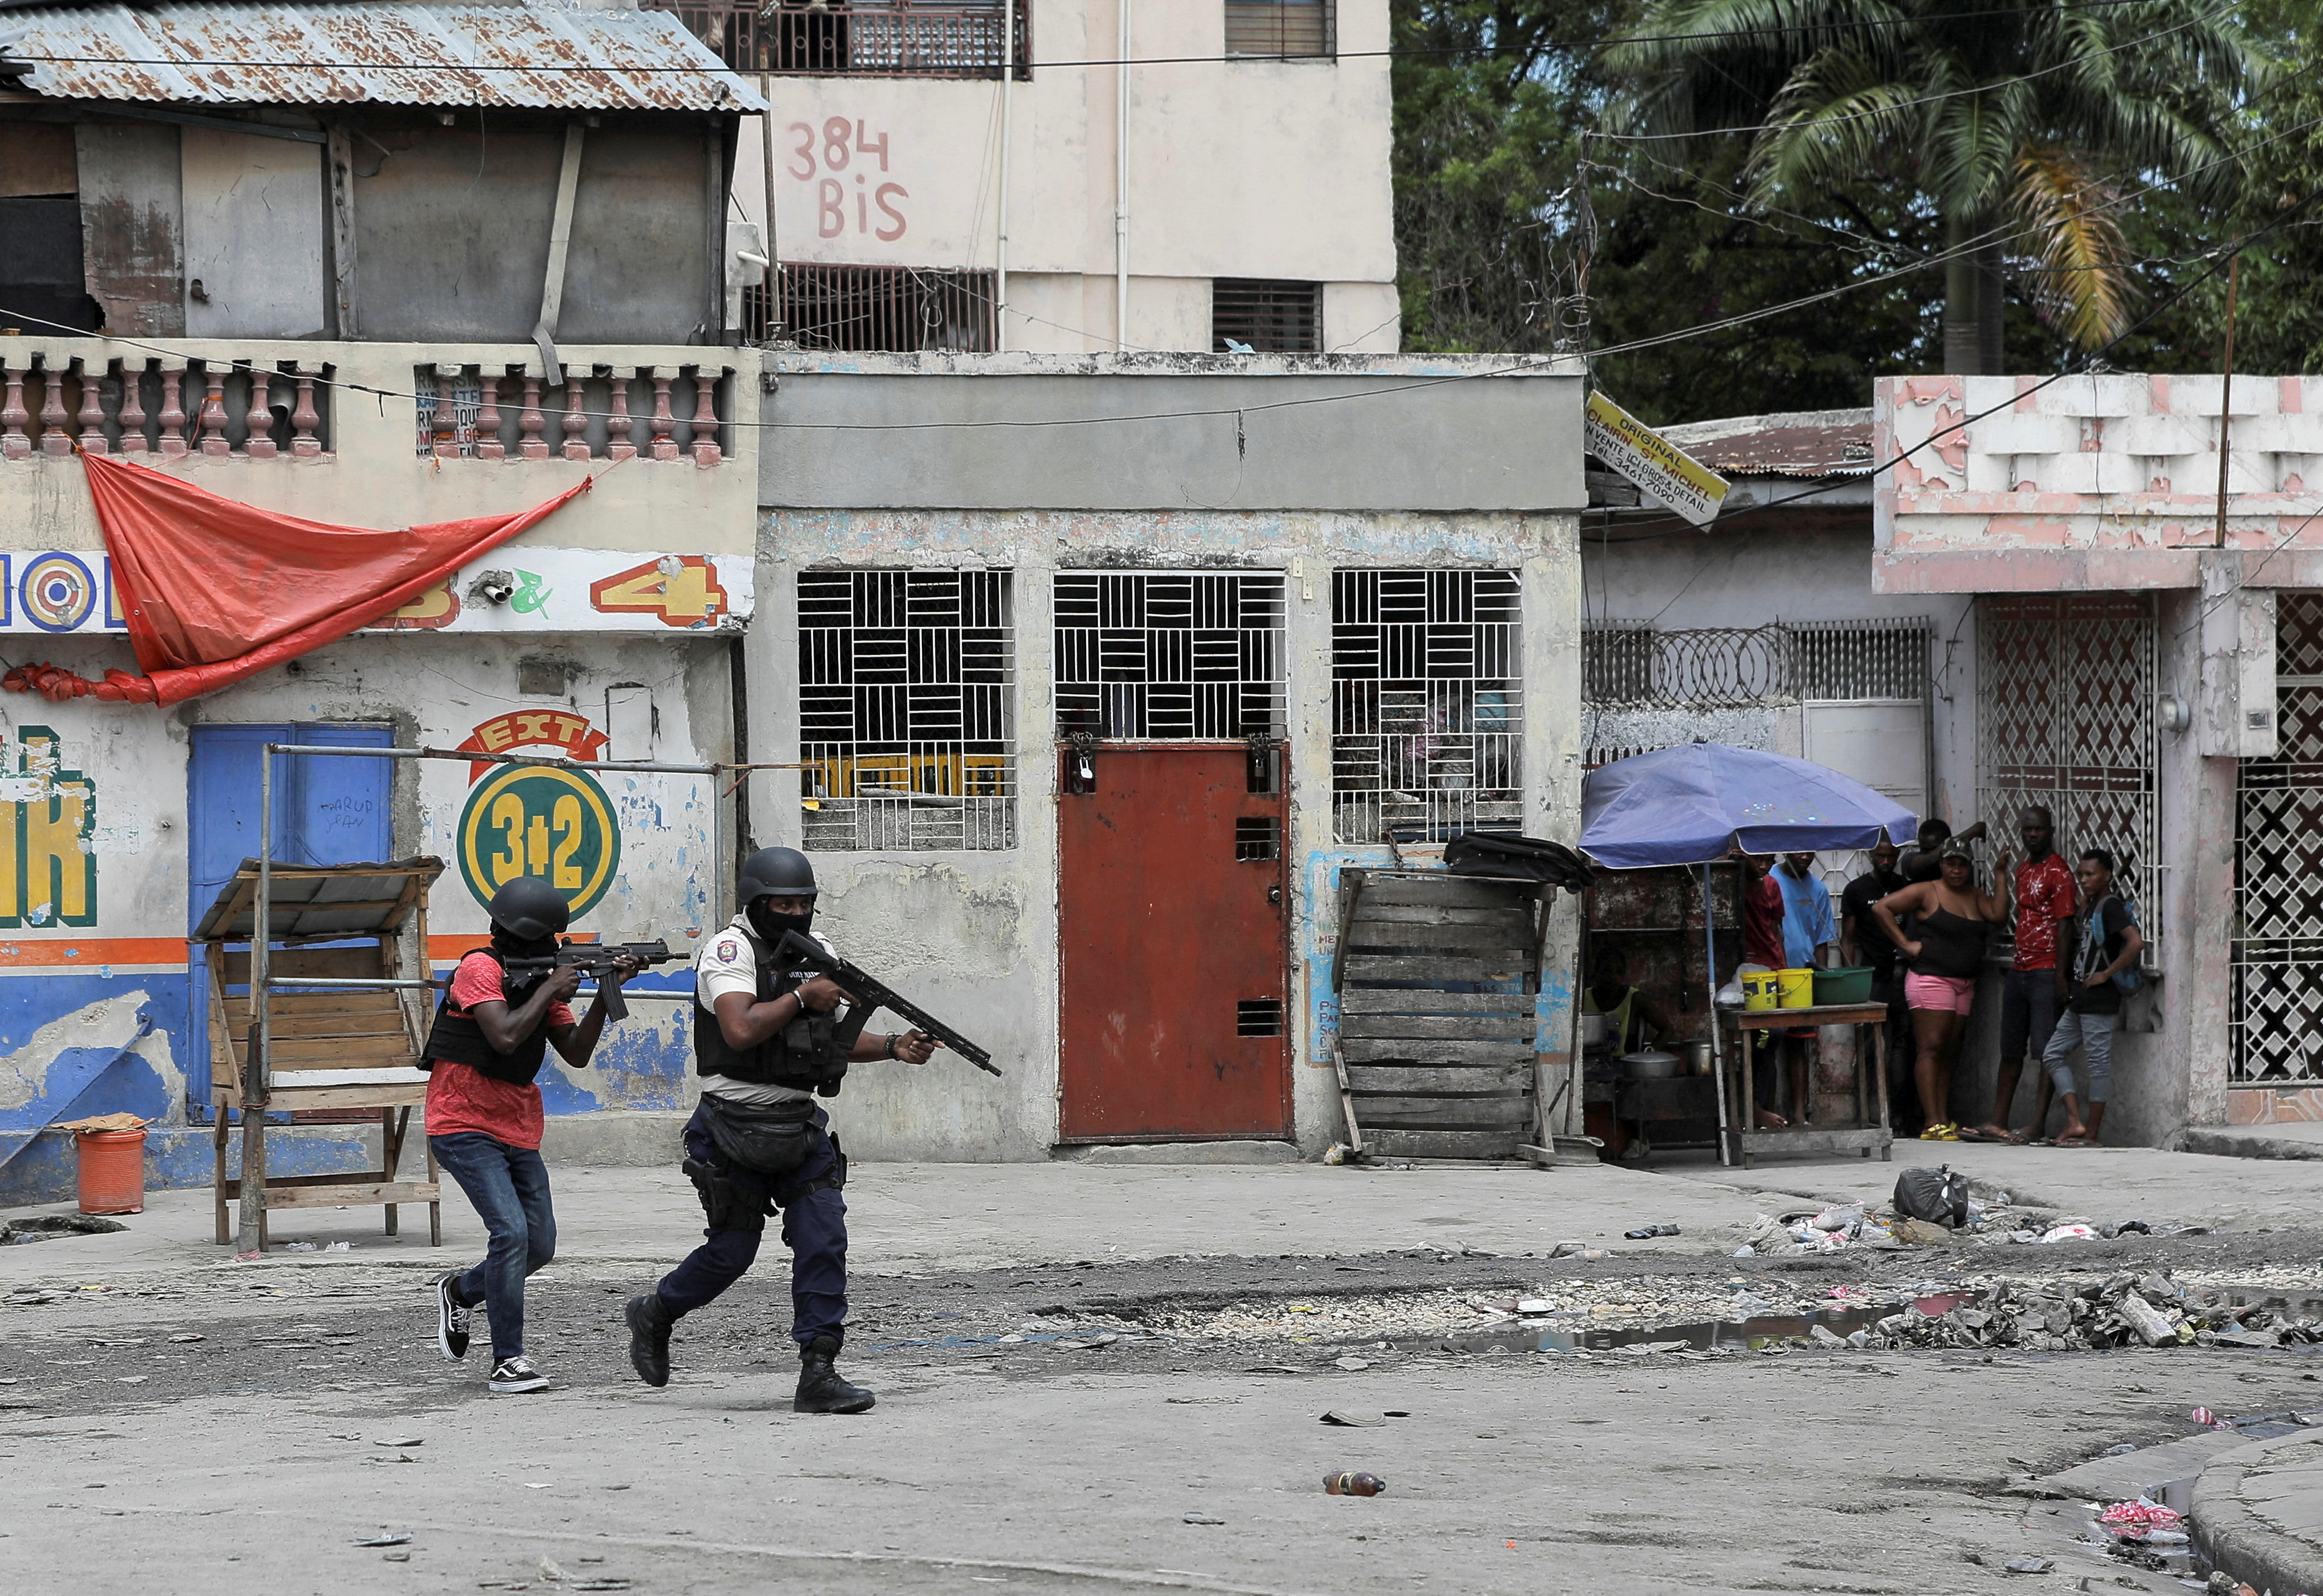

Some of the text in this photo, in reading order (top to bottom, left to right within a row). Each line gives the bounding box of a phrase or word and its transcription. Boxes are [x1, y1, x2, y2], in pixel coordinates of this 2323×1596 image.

[787, 115, 888, 181] 384
[1586, 408, 1633, 447] CLAIRIN
[1661, 463, 1711, 502] MICHEL
[1595, 429, 1624, 456] VENTE
[1642, 463, 1665, 485] GROS
[1673, 486, 1706, 514] DETAIL
[1619, 418, 1681, 468] ORIGINAL
[1615, 456, 1675, 504] 3461-7090
[590, 555, 728, 627] 4
[478, 714, 587, 753] EXT
